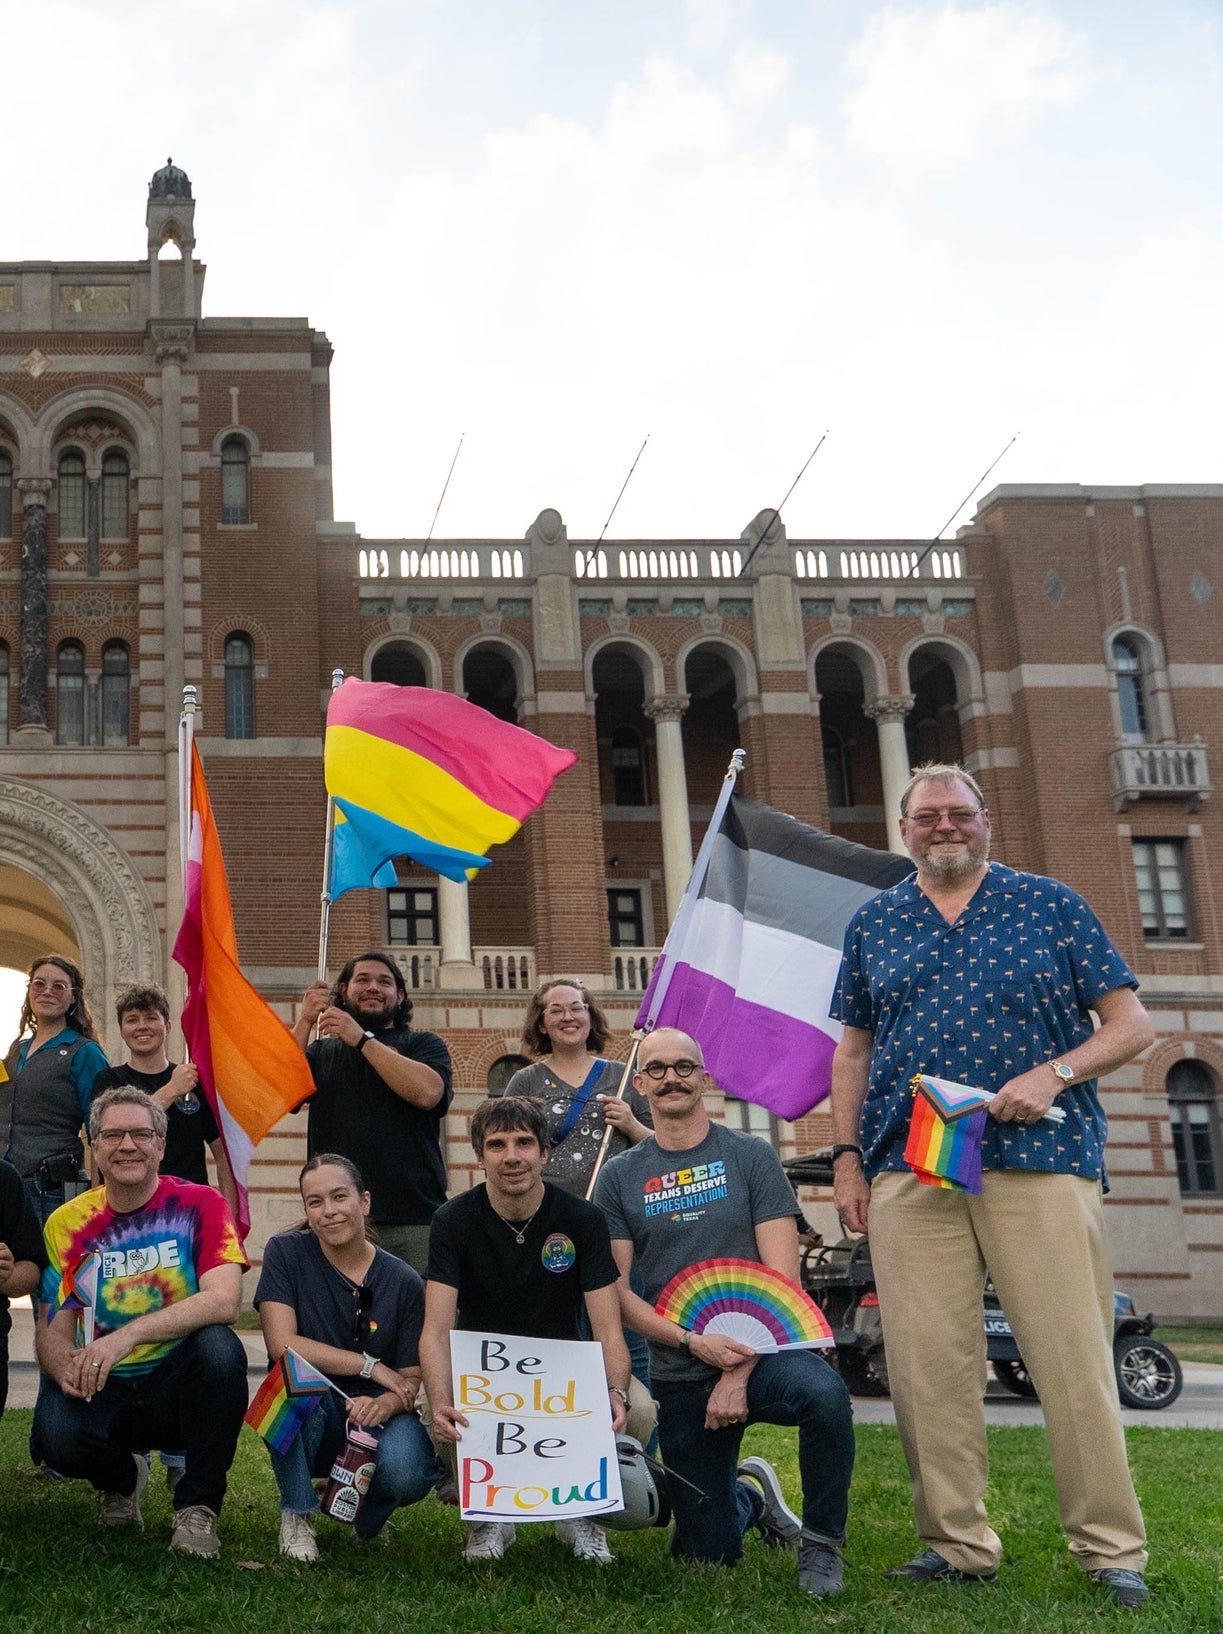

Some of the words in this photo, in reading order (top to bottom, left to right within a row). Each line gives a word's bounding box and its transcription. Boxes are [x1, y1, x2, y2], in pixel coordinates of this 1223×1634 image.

[643, 1187, 682, 1204] TEXANS
[683, 1174, 727, 1195] DESERVE
[644, 1160, 726, 1194] QUEER
[644, 1185, 728, 1218] REPRESENTATION!
[682, 1210, 706, 1218] EQUALITY
[104, 1254, 112, 1276] RICE
[481, 1339, 547, 1375] Be
[459, 1374, 576, 1414] Bold
[496, 1422, 567, 1458] Be
[462, 1456, 608, 1509] Proud
[332, 1508, 354, 1520] LIBRARY
[333, 1504, 355, 1515] PUBLIC
[335, 1499, 356, 1511] BOSTON
